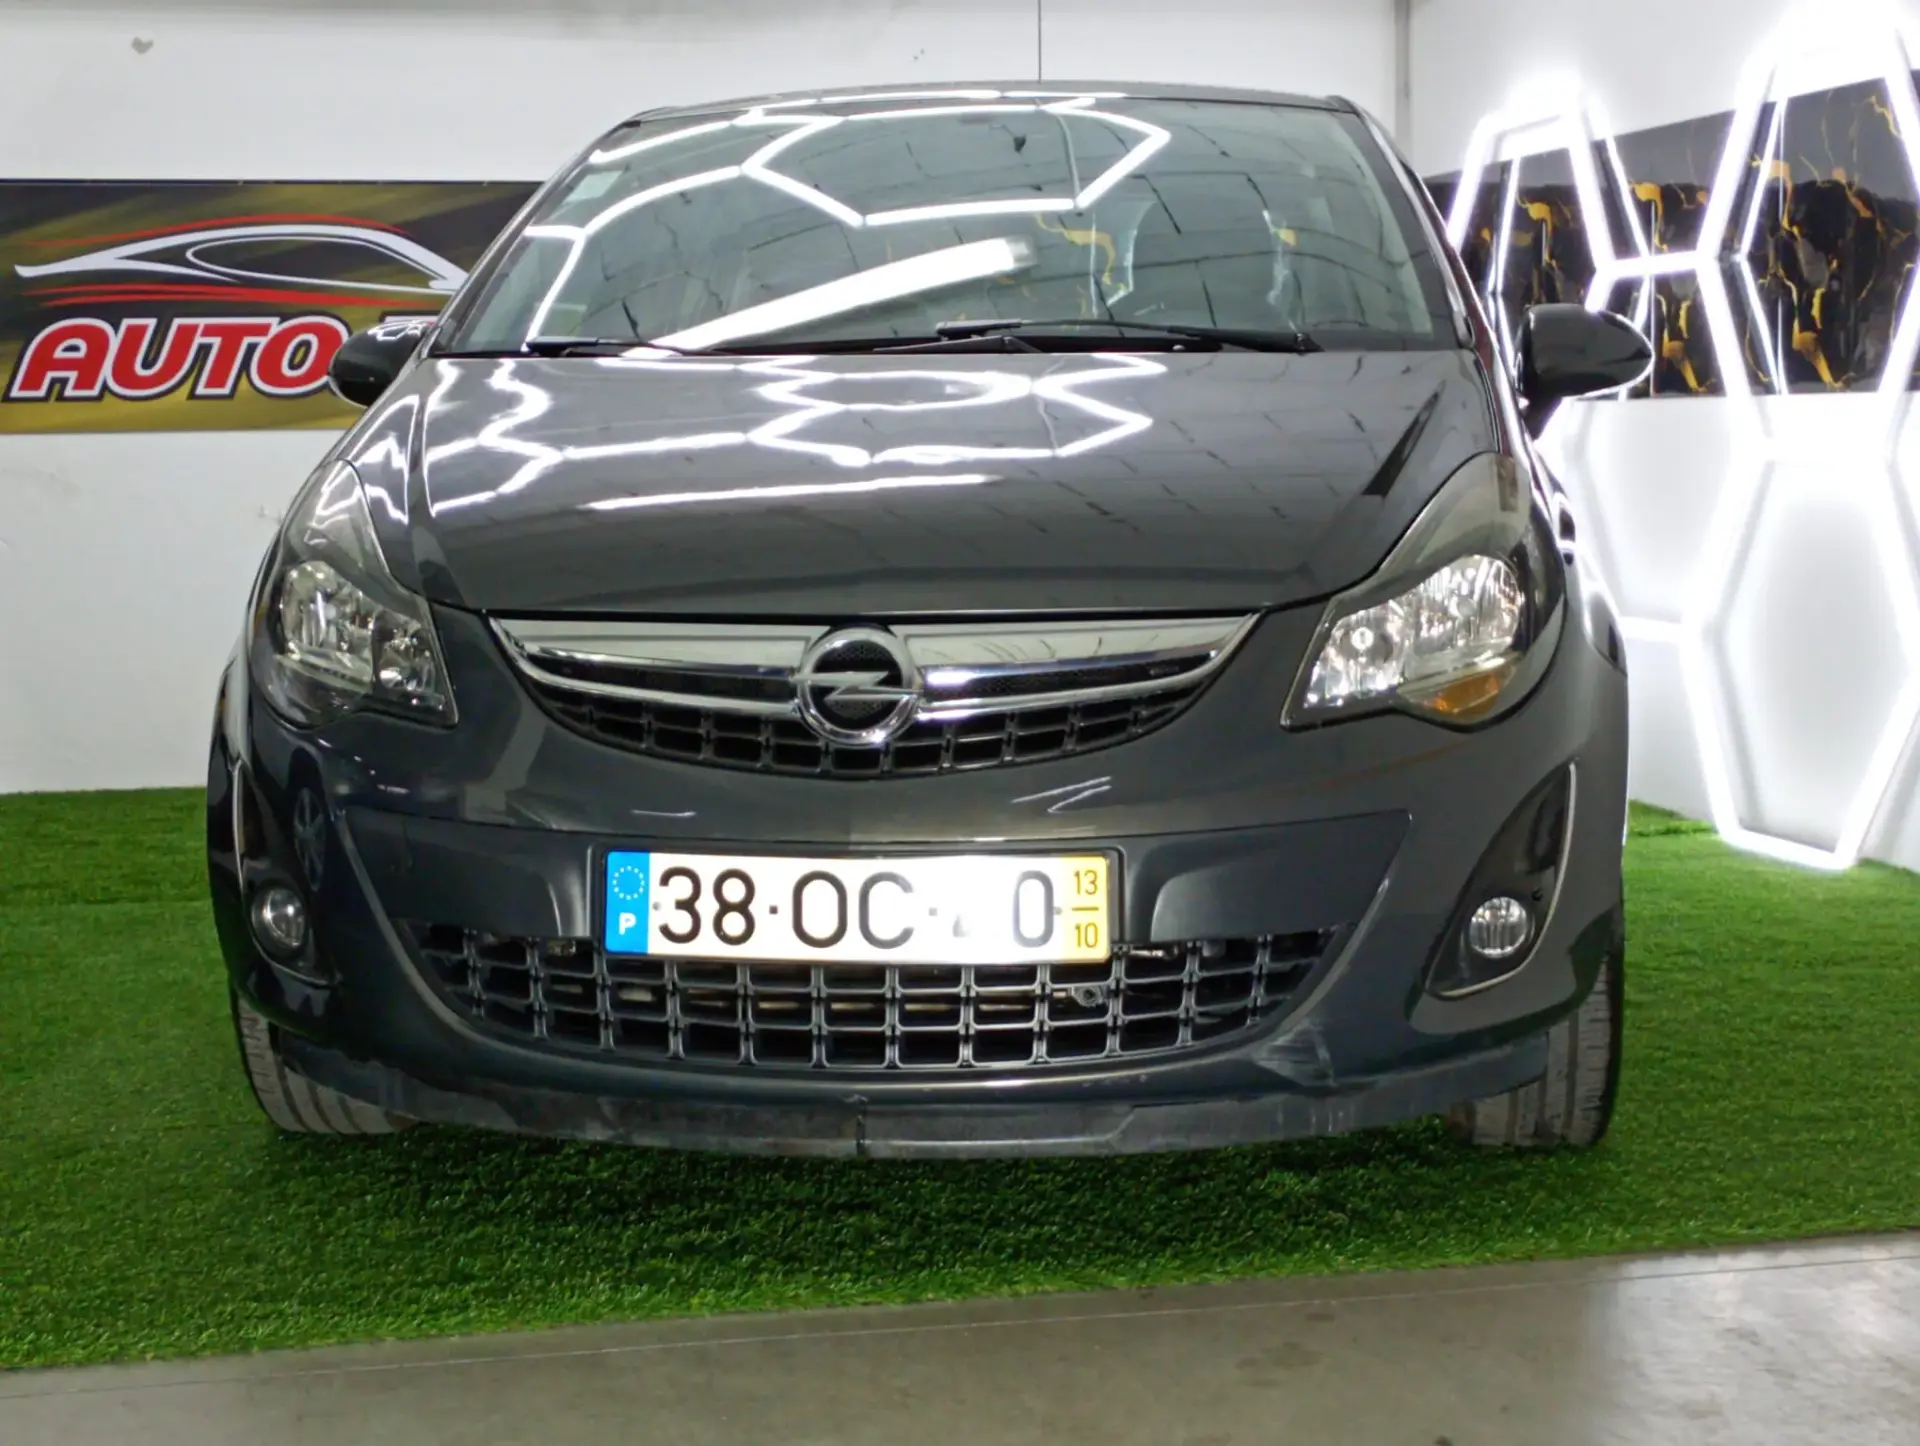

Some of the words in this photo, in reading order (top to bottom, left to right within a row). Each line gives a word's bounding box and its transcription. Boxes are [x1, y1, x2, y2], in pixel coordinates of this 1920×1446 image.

[9, 315, 350, 399] AUTO
[1072, 870, 1099, 896] 13
[619, 913, 636, 935] P
[1074, 922, 1099, 949] 10
